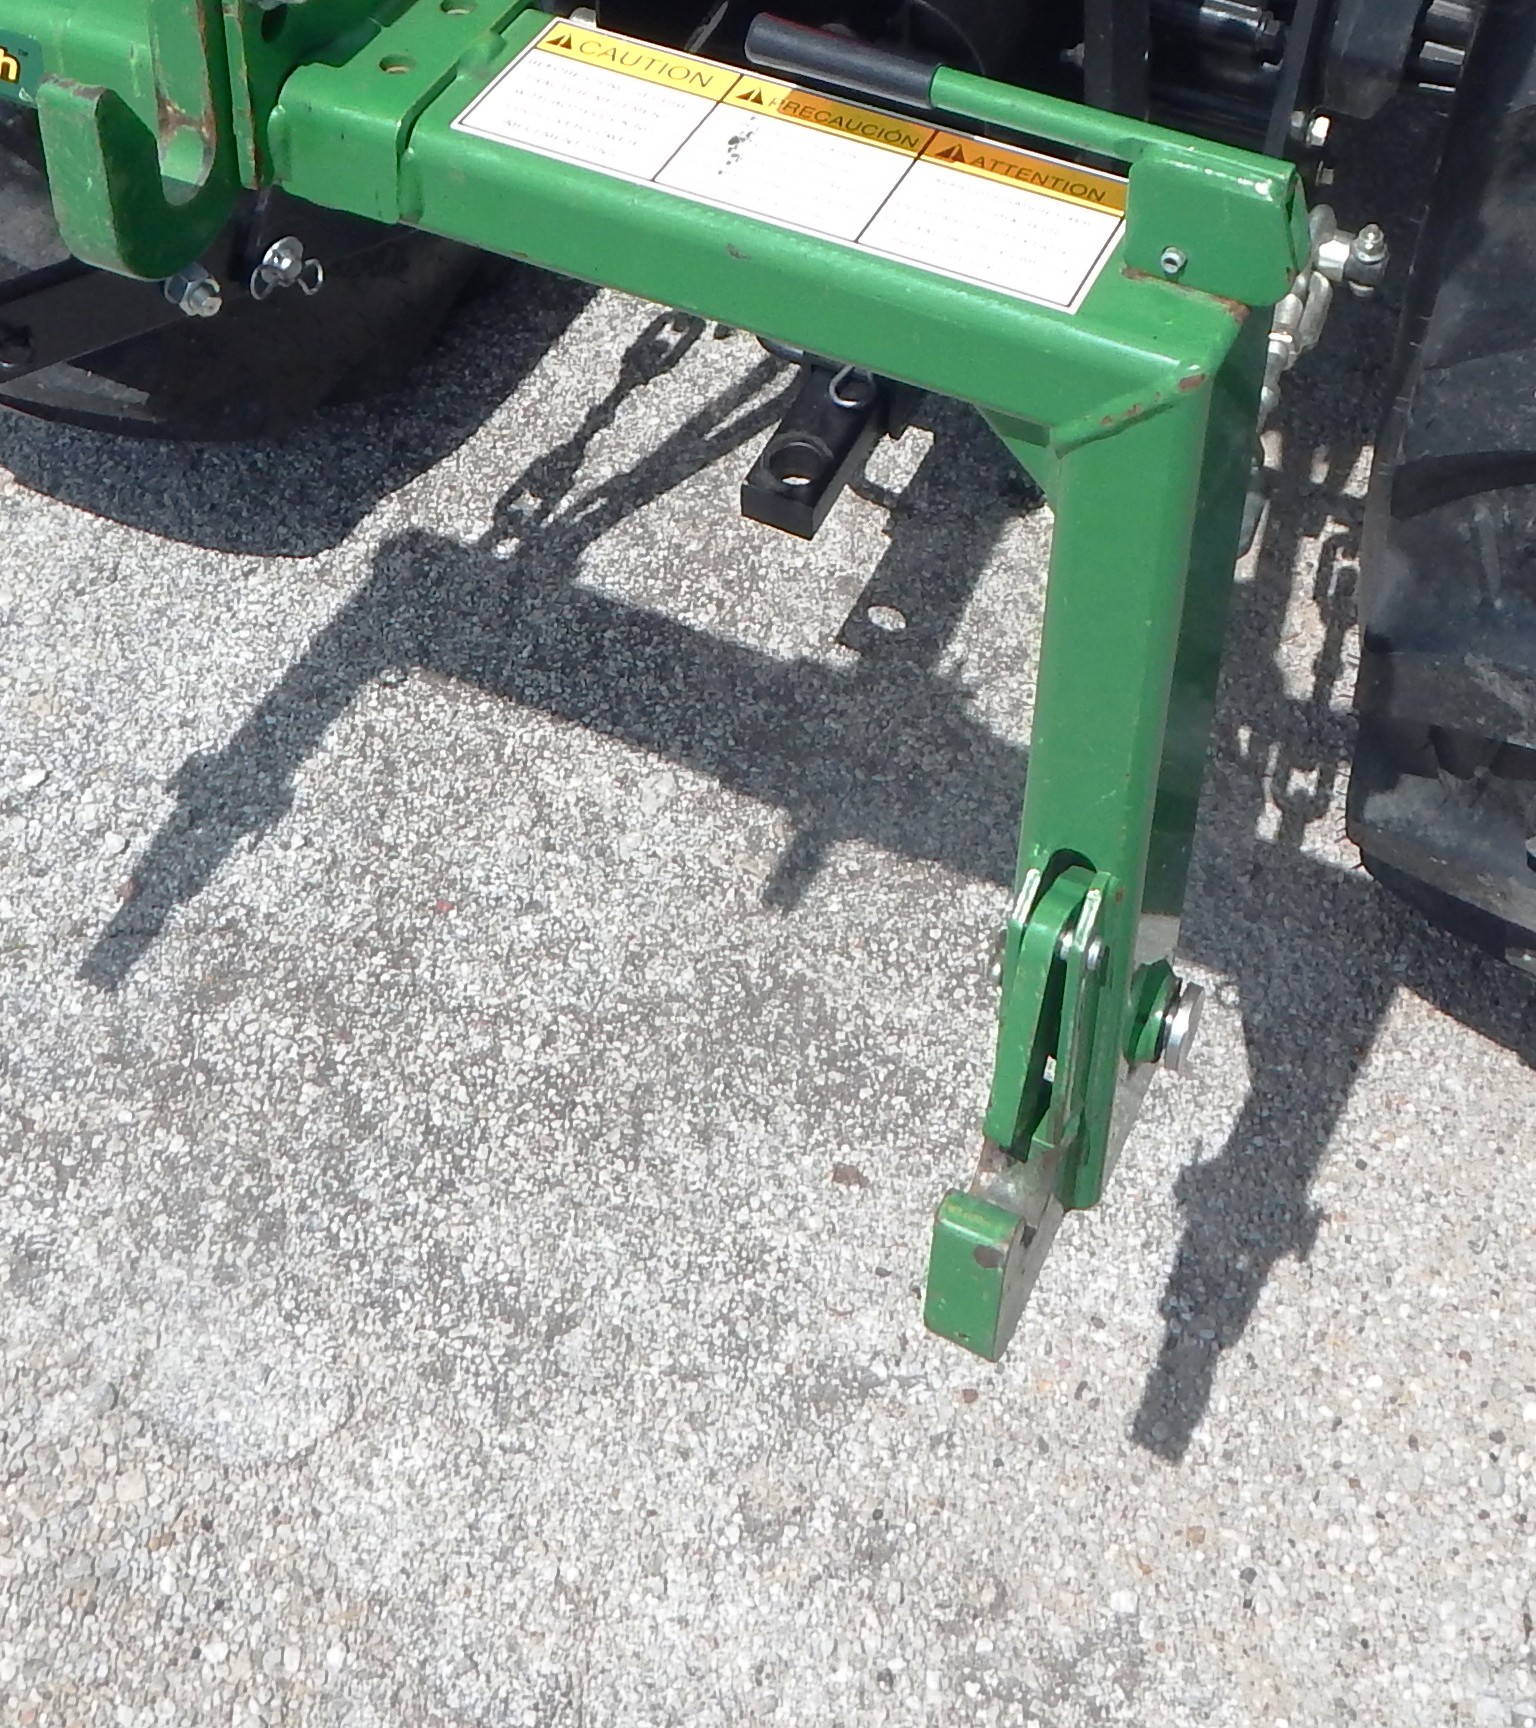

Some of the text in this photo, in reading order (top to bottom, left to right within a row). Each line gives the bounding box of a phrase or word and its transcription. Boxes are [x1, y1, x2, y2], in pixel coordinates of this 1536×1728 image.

[578, 40, 714, 88] CAUTION
[767, 97, 920, 148] PRECAUCIÓN
[969, 155, 1107, 202] ATTENTION
